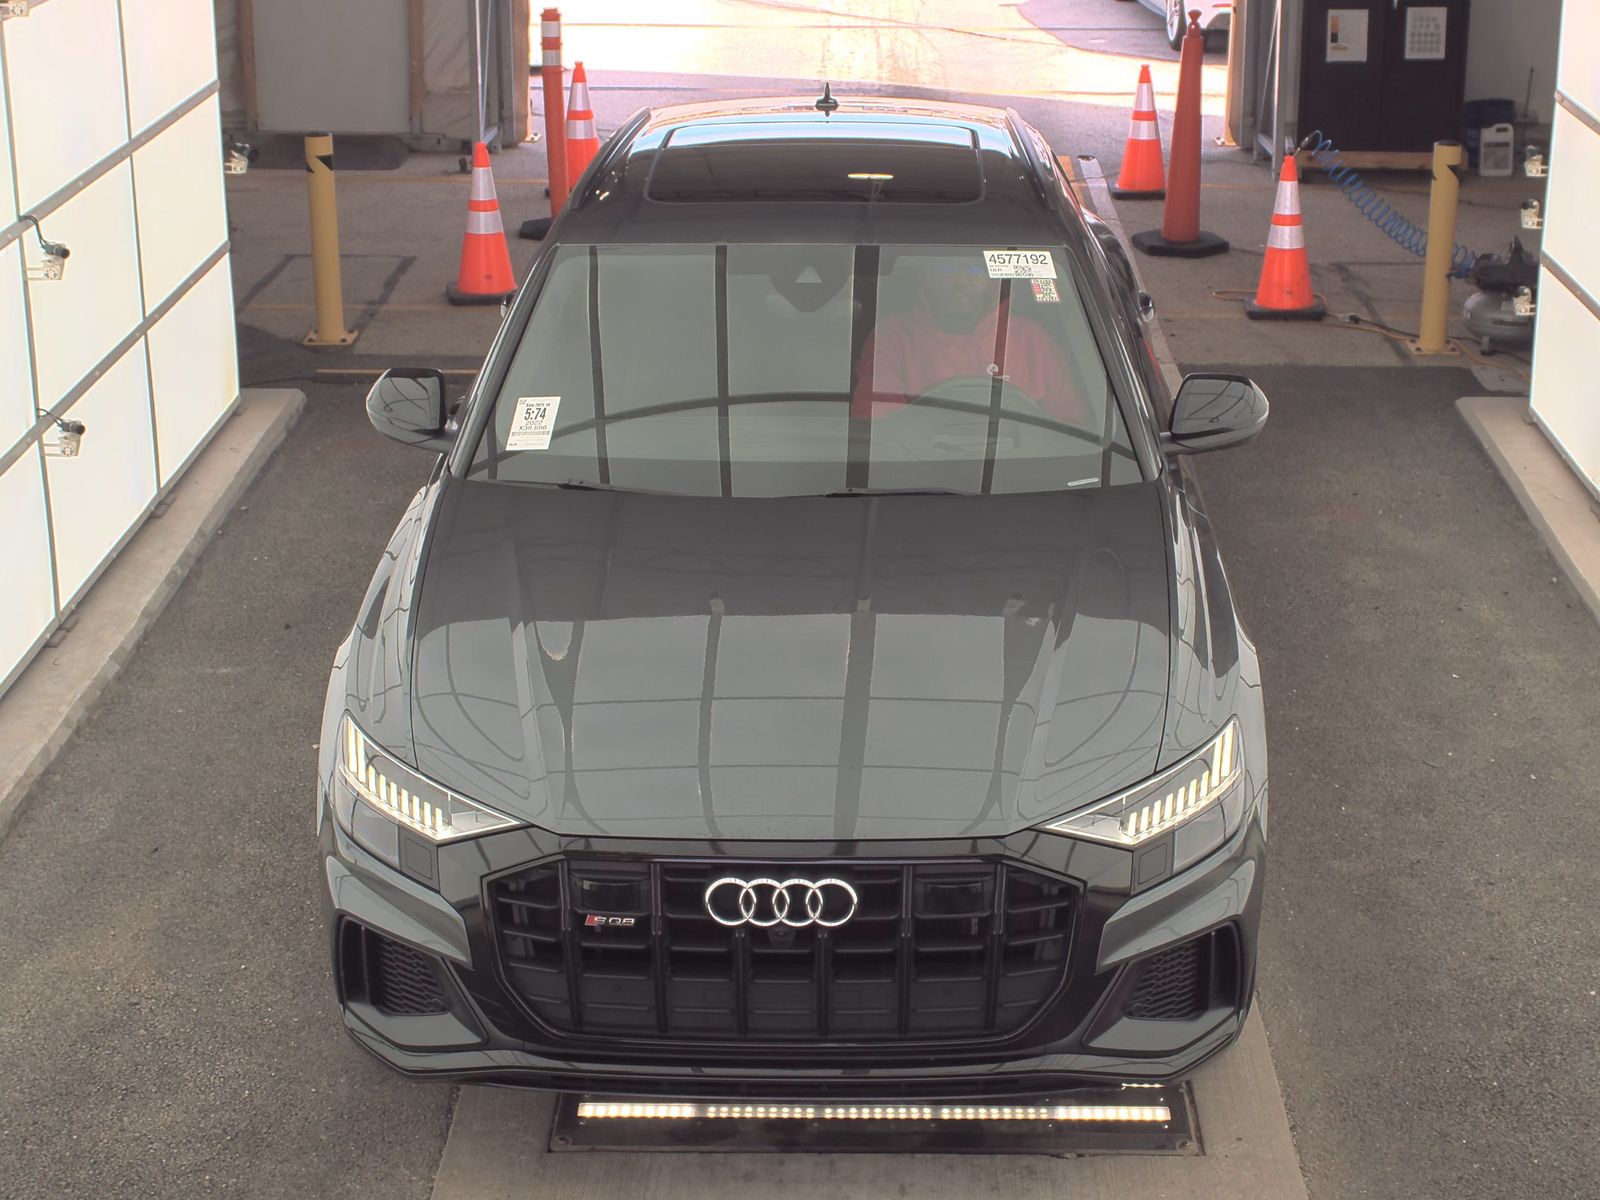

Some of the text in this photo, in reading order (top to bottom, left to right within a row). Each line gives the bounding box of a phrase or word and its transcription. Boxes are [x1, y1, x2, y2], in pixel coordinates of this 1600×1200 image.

[988, 254, 1049, 265] 4577192
[524, 407, 547, 421] 5:74
[593, 916, 636, 926] SQ8
